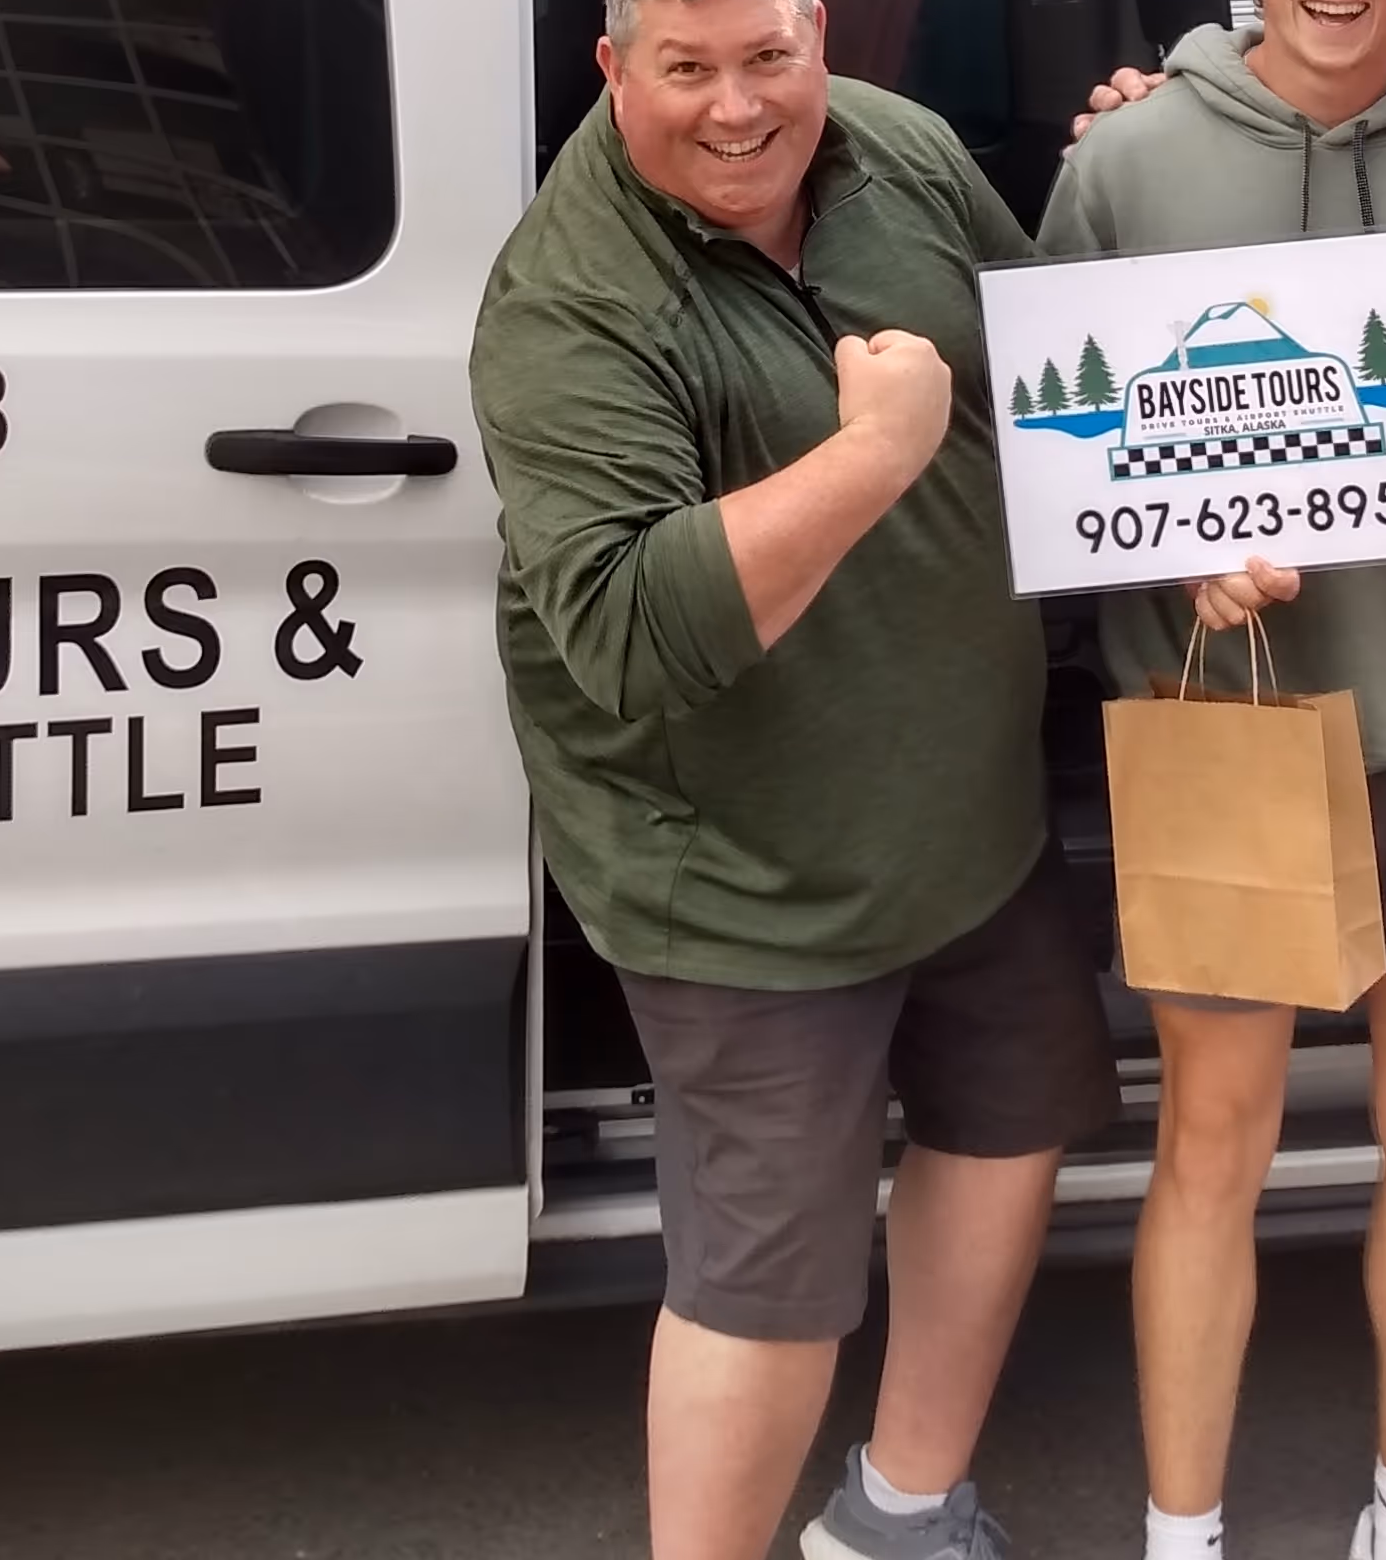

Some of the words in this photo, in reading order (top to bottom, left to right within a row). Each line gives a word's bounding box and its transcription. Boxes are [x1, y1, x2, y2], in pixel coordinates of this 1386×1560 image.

[1136, 374, 1250, 420] BAYSIDE
[1251, 365, 1341, 409] TOURS
[1181, 416, 1219, 426] TOURS
[1236, 410, 1287, 422] AIRPORT
[1293, 404, 1345, 416] SHUTTLE
[1203, 423, 1240, 436] SITKA,
[1242, 419, 1286, 433] ALASKA
[274, 559, 364, 680] &
